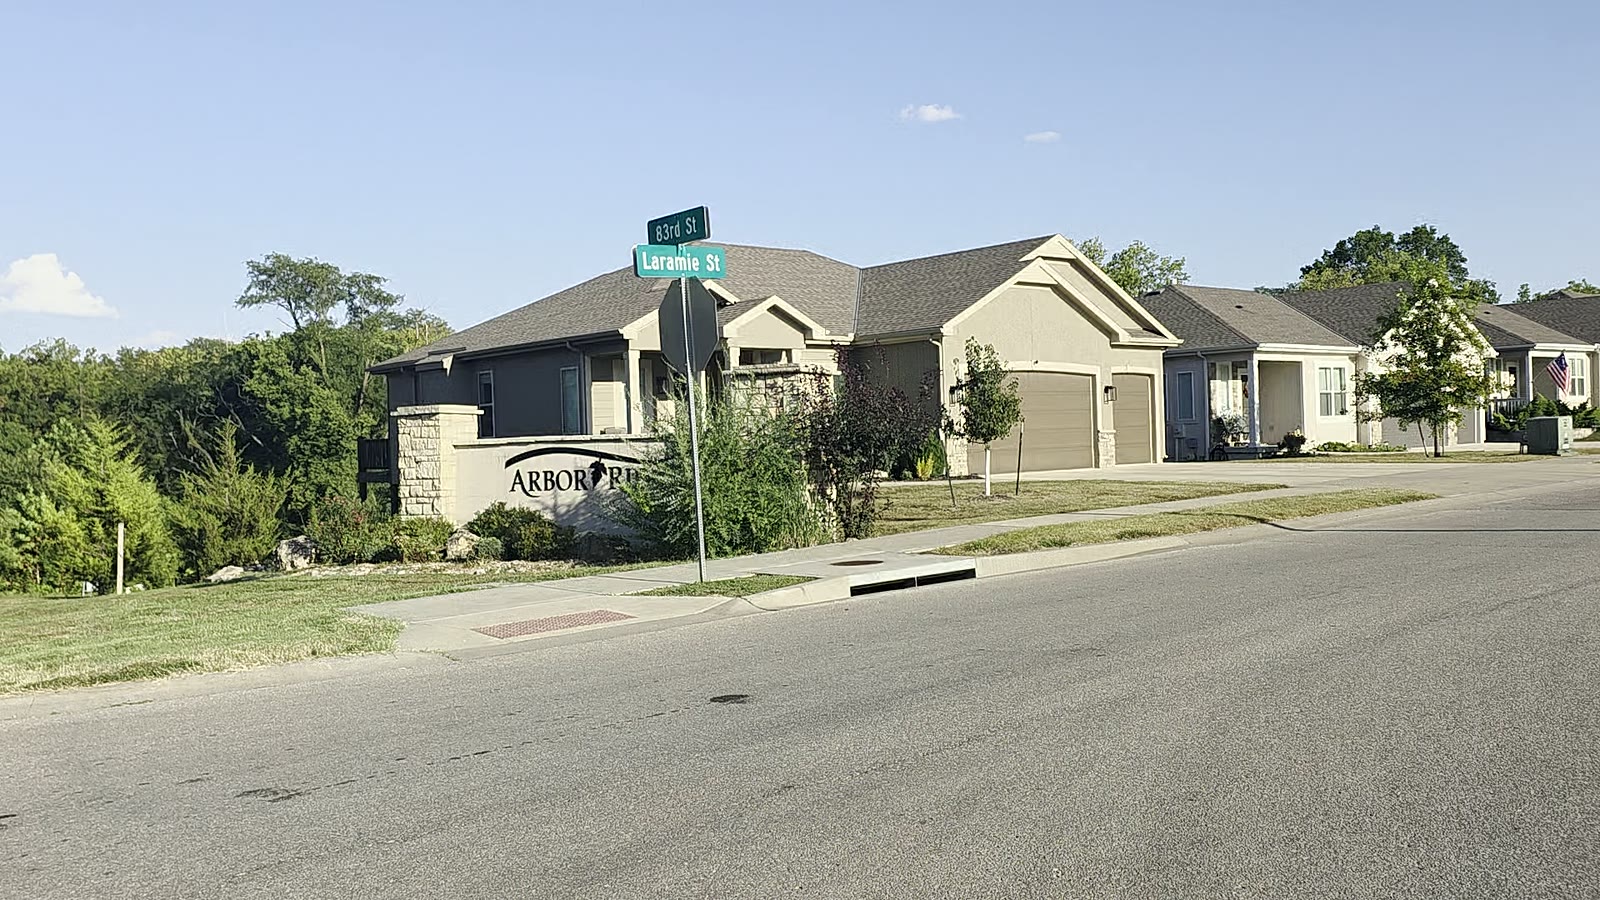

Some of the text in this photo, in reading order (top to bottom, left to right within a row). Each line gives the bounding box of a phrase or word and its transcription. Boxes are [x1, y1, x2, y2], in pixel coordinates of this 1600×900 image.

[655, 216, 697, 242] 83rd St
[641, 251, 721, 273] Laramie St
[509, 468, 589, 498] ARBOR
